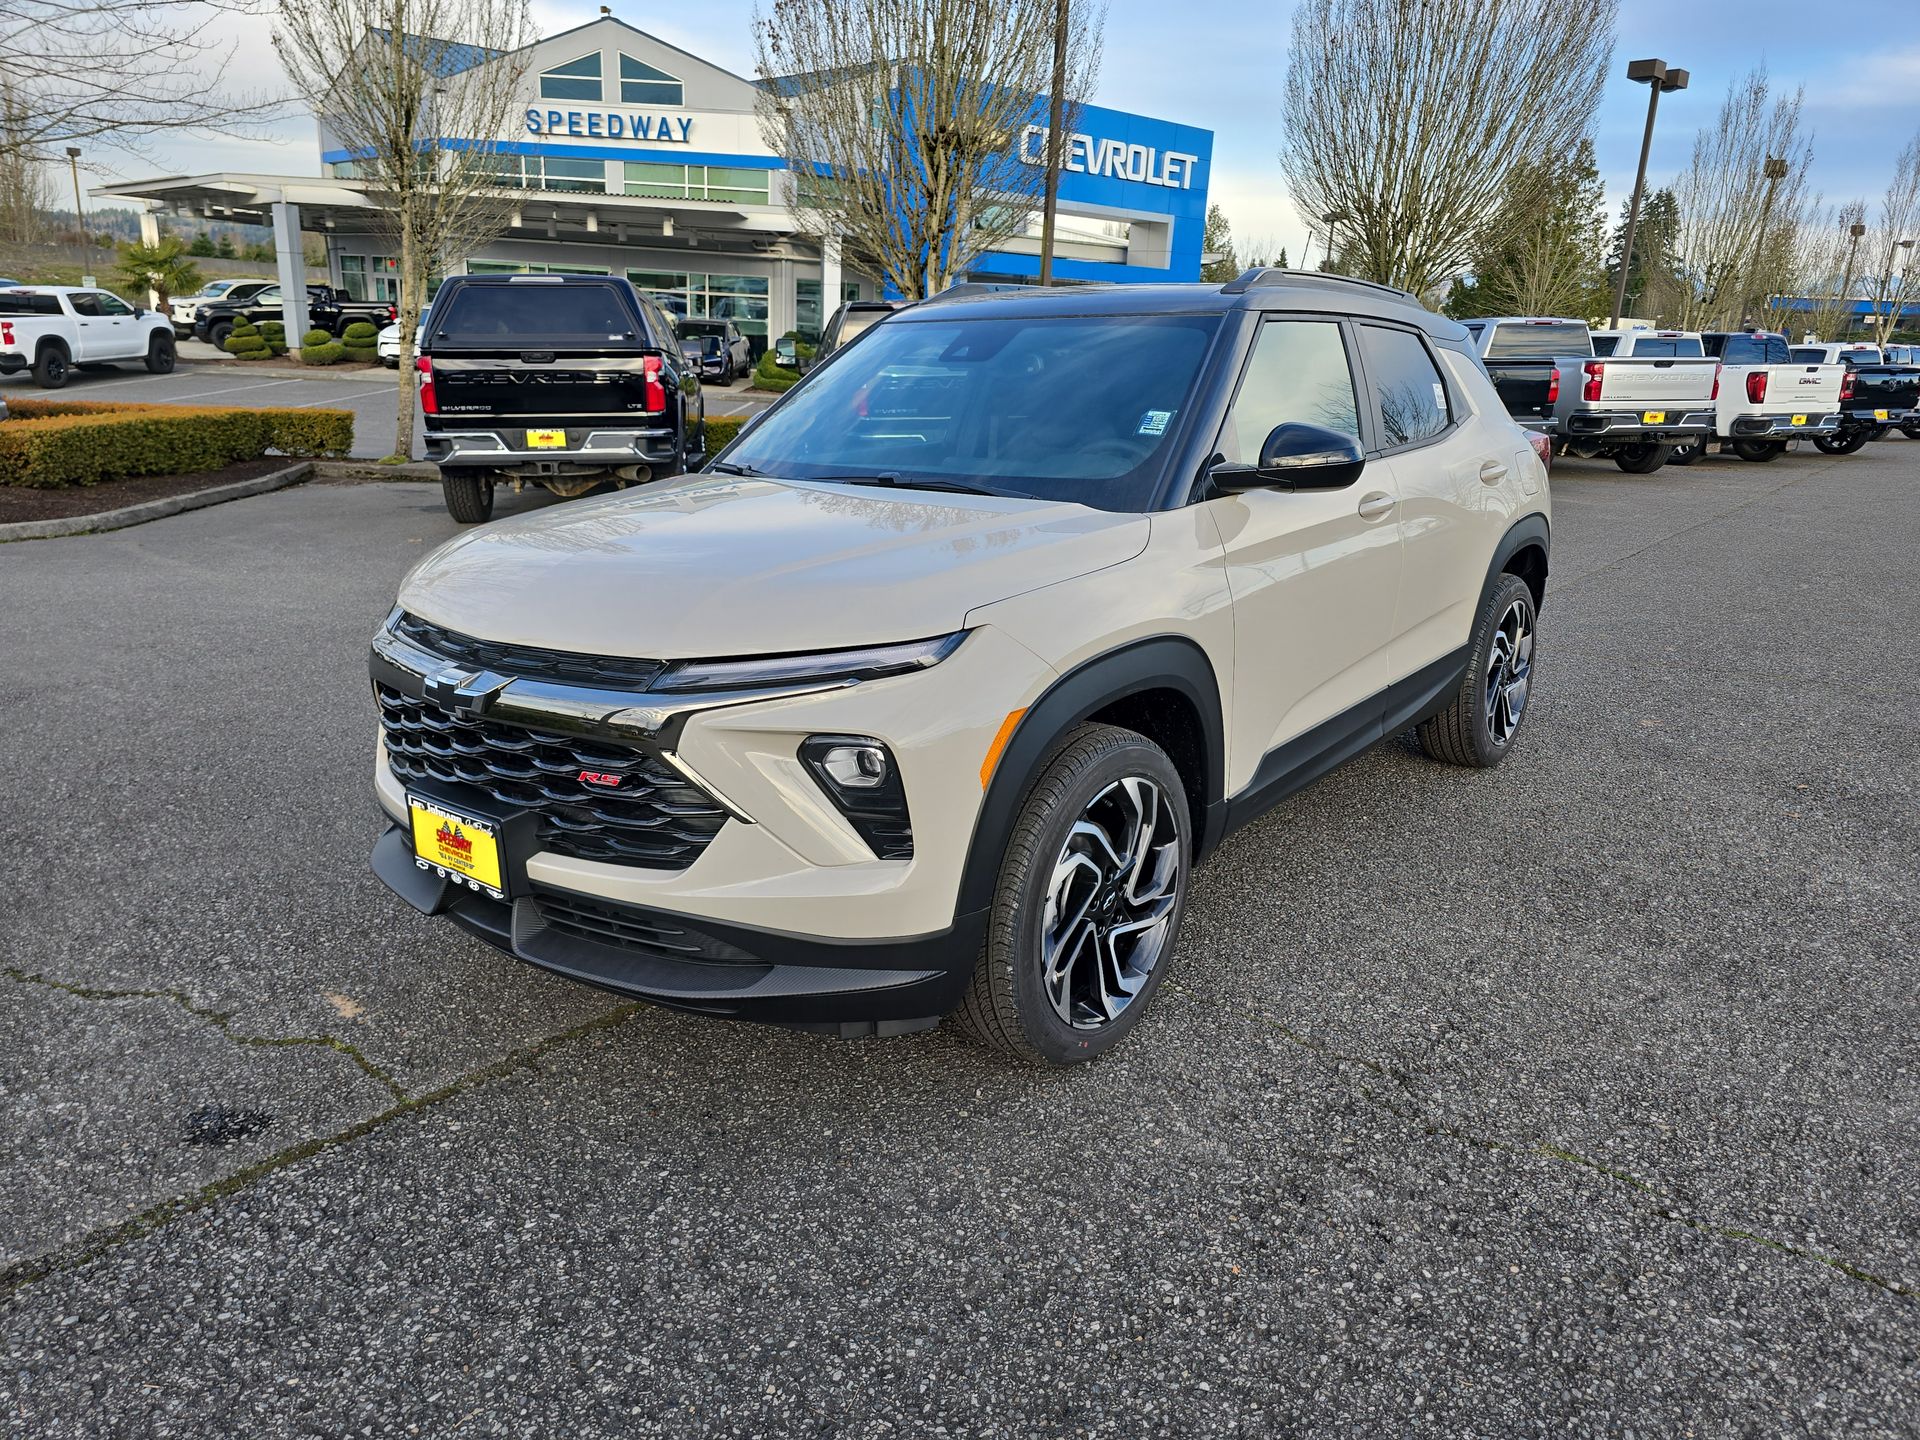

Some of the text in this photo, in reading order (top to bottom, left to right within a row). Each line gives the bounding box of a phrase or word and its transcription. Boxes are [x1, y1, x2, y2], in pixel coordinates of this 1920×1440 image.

[526, 109, 693, 142] SPEEDWAY
[447, 373, 631, 385] CHEVROLET
[1612, 373, 1709, 382] CHEVROLET
[1799, 377, 1822, 385] GMC
[576, 770, 622, 786] RS
[436, 828, 473, 853] SPEEDWAY
[438, 844, 473, 862] CHEVROLET
